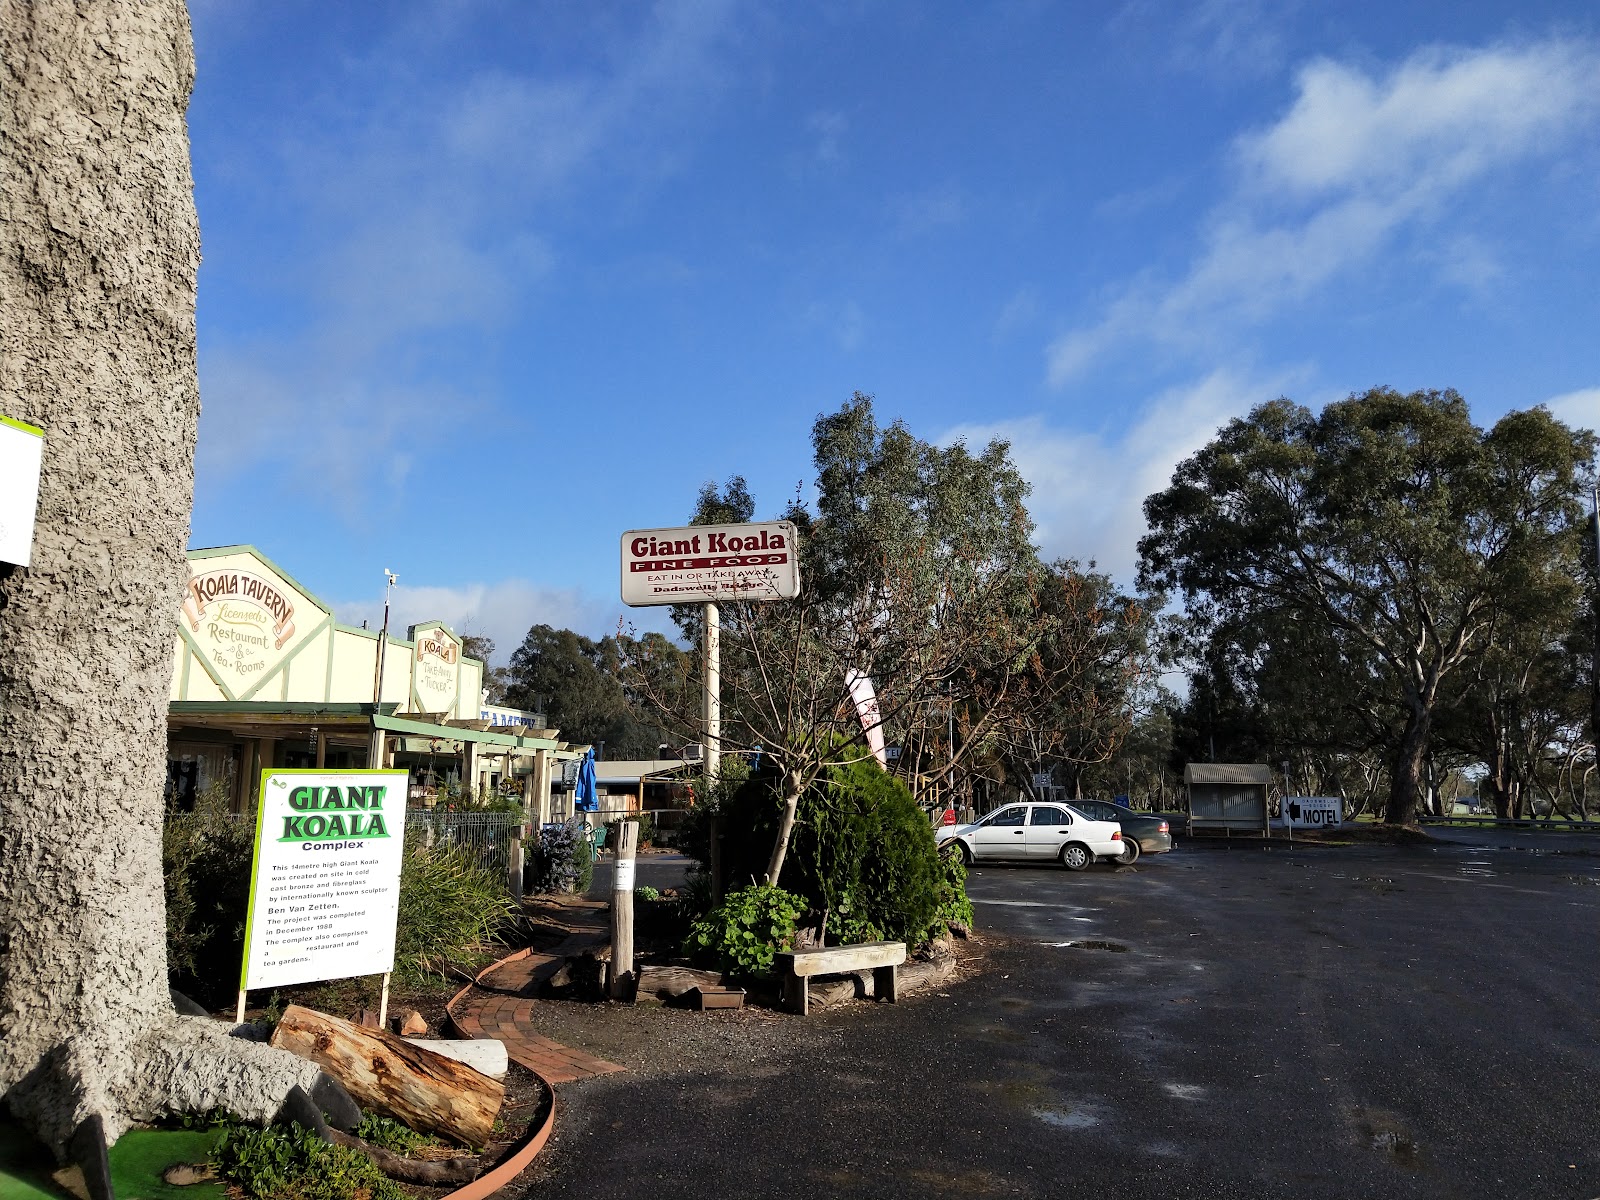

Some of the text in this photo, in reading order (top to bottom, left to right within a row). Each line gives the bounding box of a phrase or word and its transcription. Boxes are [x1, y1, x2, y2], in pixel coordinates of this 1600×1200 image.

[631, 531, 785, 557] Giant Koala
[635, 556, 782, 570] FINE FOOD
[647, 574, 668, 582] EAT
[686, 572, 702, 580] OR
[706, 570, 735, 578] TAKE
[737, 569, 768, 577] AWAY
[194, 575, 292, 623] KOALA TAVERN
[212, 603, 267, 624] Licensed
[207, 622, 270, 650] Restaurant
[235, 644, 244, 660] &
[424, 640, 450, 661] KOALA
[212, 648, 265, 676] Tea Rooms
[289, 786, 386, 811] GIANT
[1302, 810, 1340, 824] MOTEL
[281, 814, 388, 840] KOALA
[302, 841, 364, 852] Complex
[332, 879, 366, 887] fibreglass
[280, 891, 334, 902] internationally
[284, 916, 310, 925] project
[330, 910, 366, 920] completed
[276, 925, 314, 934] December
[282, 935, 313, 944] complex
[332, 930, 368, 939] comprises
[306, 942, 344, 952] restaurant
